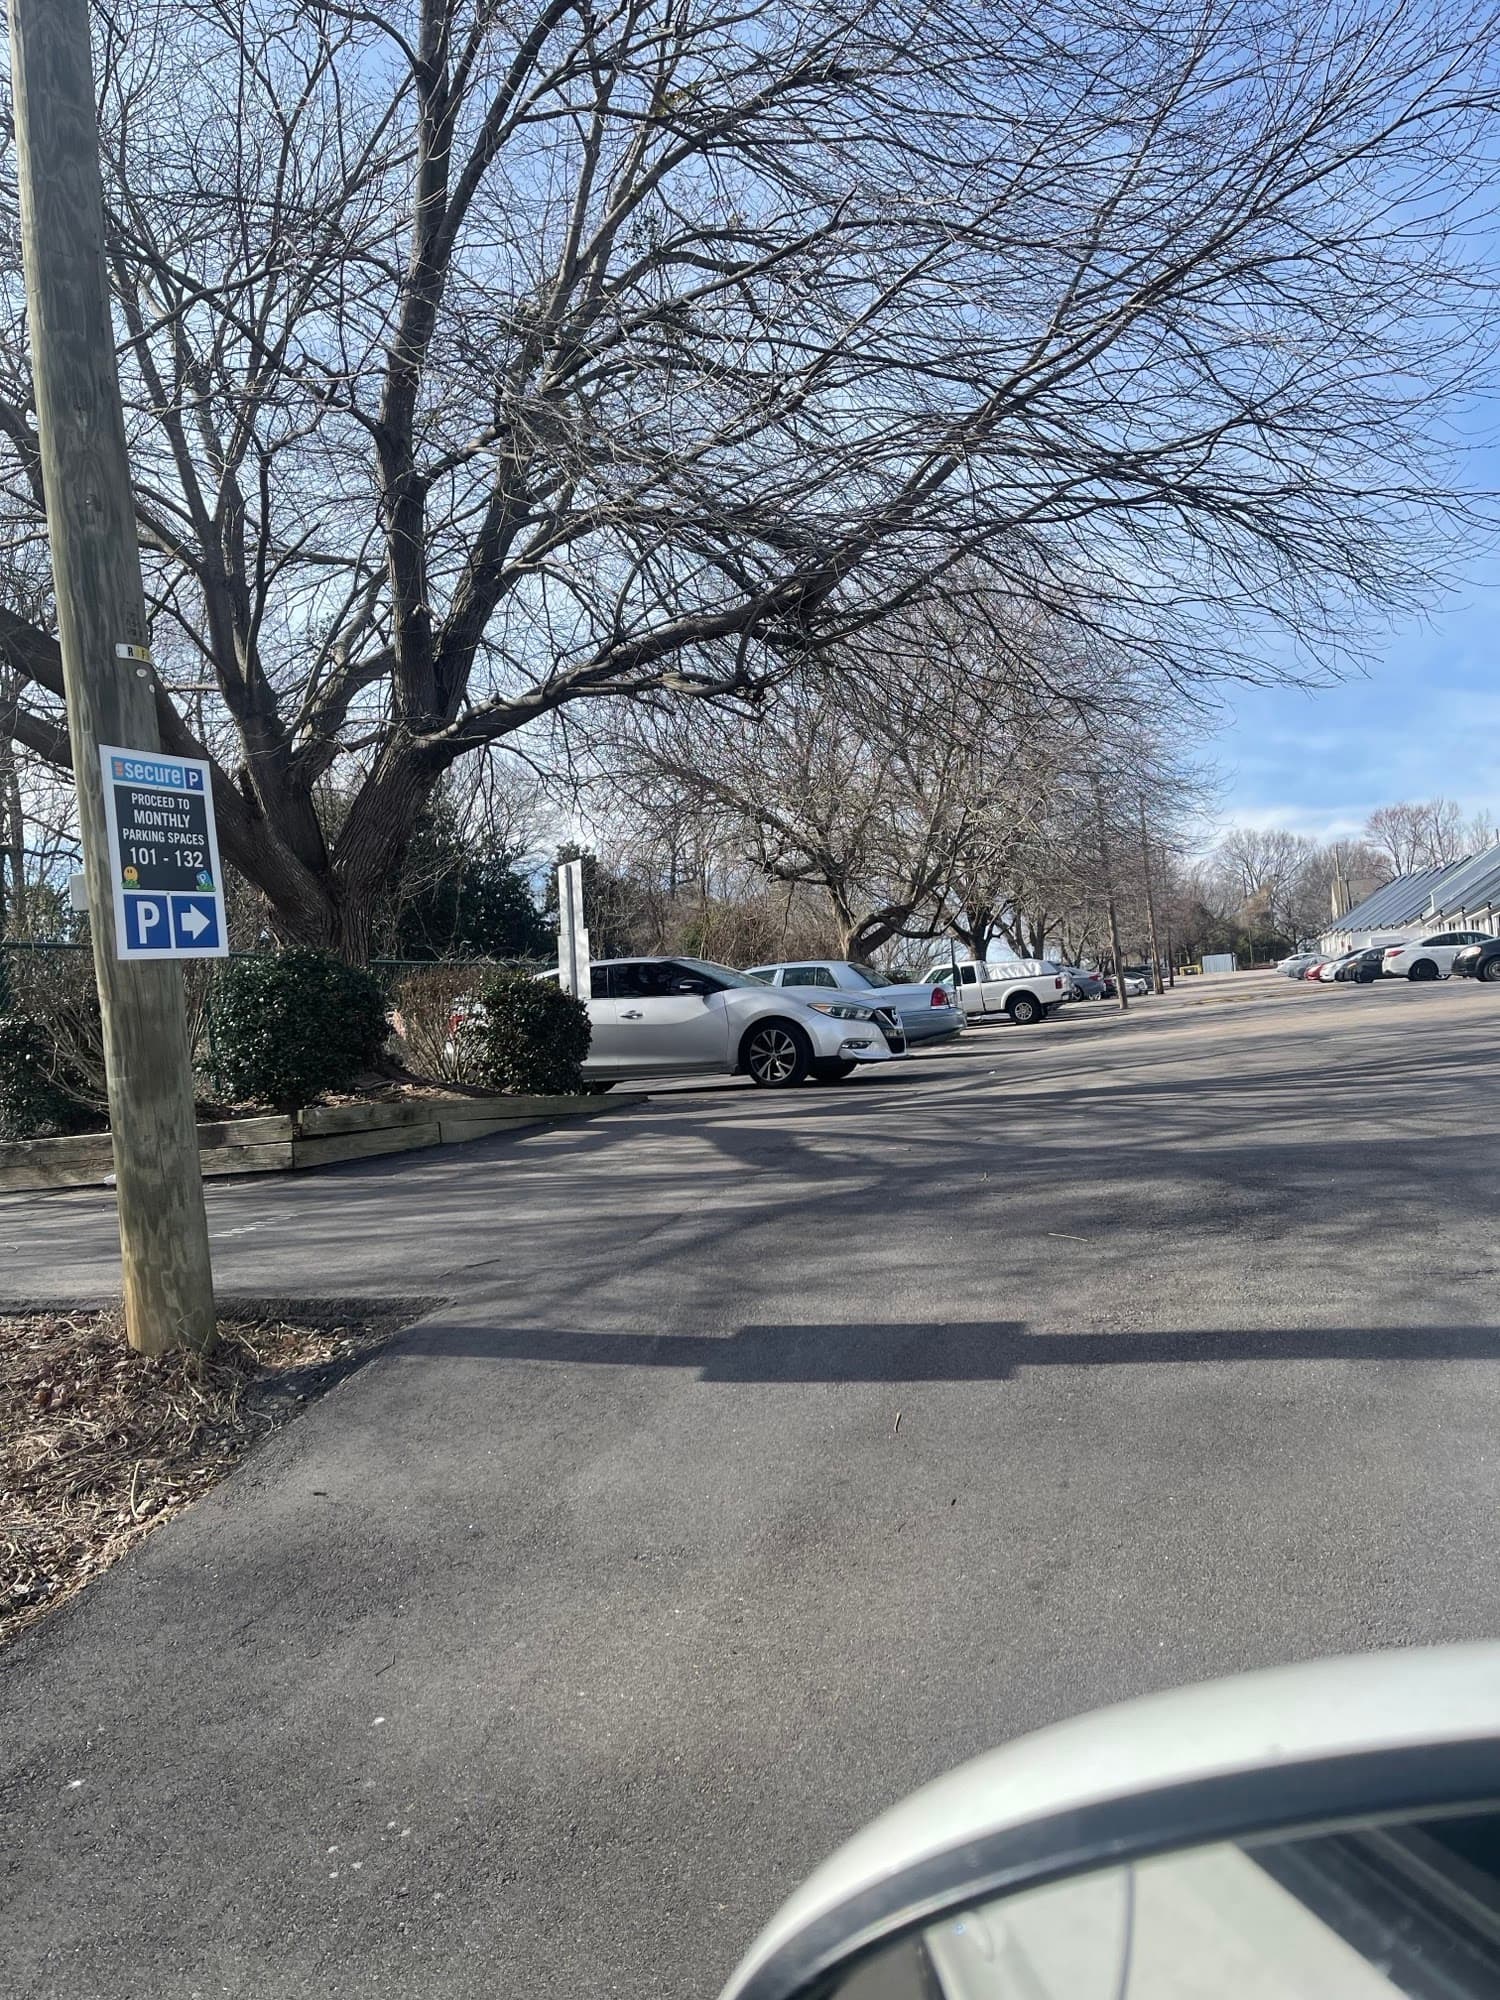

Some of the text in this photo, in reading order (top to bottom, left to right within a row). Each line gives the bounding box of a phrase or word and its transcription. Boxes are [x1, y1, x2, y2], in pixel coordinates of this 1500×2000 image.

[124, 762, 199, 787] secure P
[131, 792, 190, 811] PROCEED TO
[134, 809, 190, 829] MONTHLY
[122, 828, 205, 846] PARKING SPACES
[129, 847, 157, 865] 101
[174, 850, 204, 868] 132
[136, 901, 160, 944] P
